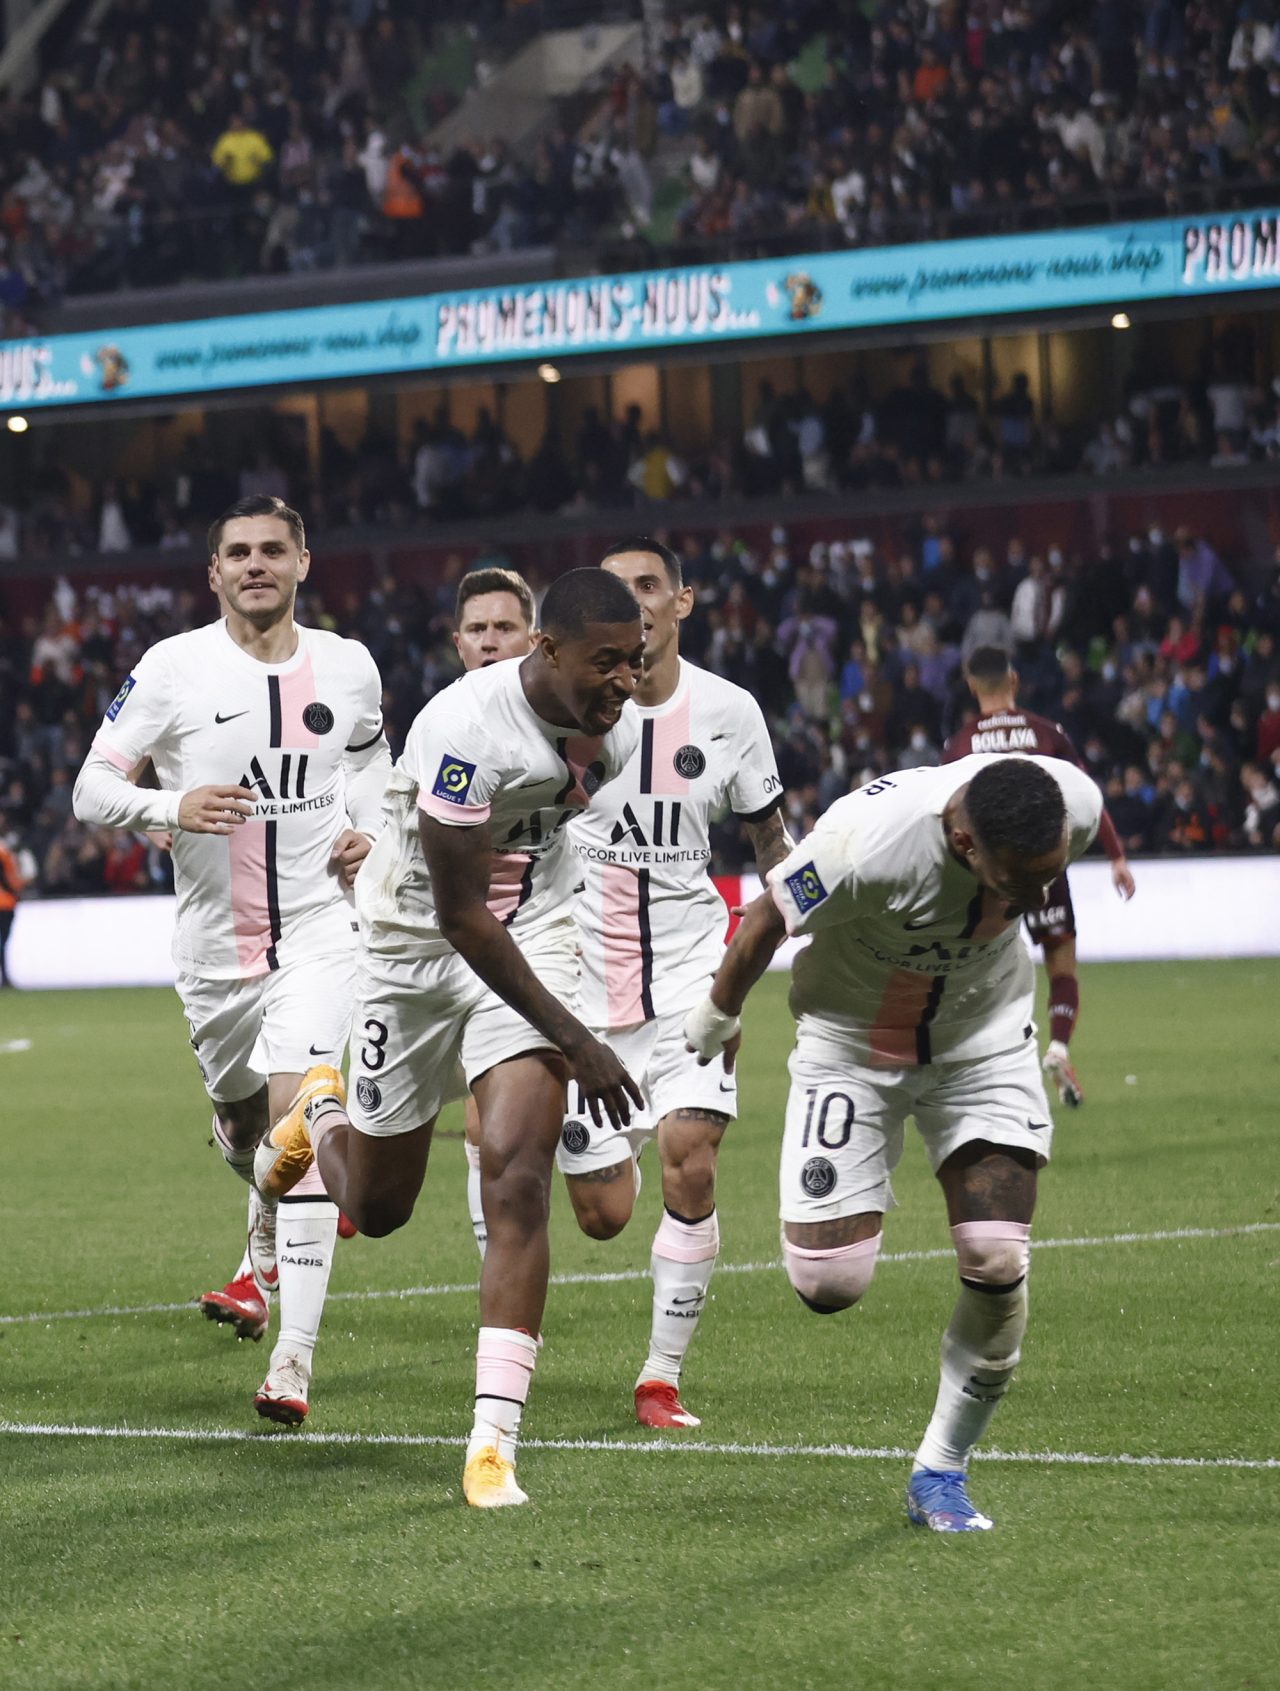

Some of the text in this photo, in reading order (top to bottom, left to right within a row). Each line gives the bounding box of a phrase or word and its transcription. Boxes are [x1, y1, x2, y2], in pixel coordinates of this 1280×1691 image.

[971, 727, 1038, 753] BOULAYA
[436, 789, 457, 802] LIGUE
[250, 804, 278, 816] IVE
[282, 794, 335, 814] LIMITLESS
[622, 852, 652, 863] LIVE
[655, 849, 711, 863] LIMITLESS
[915, 963, 952, 972] LIVE
[362, 1019, 388, 1070] 3
[802, 1088, 855, 1149] 10
[281, 1254, 323, 1267] PARIS
